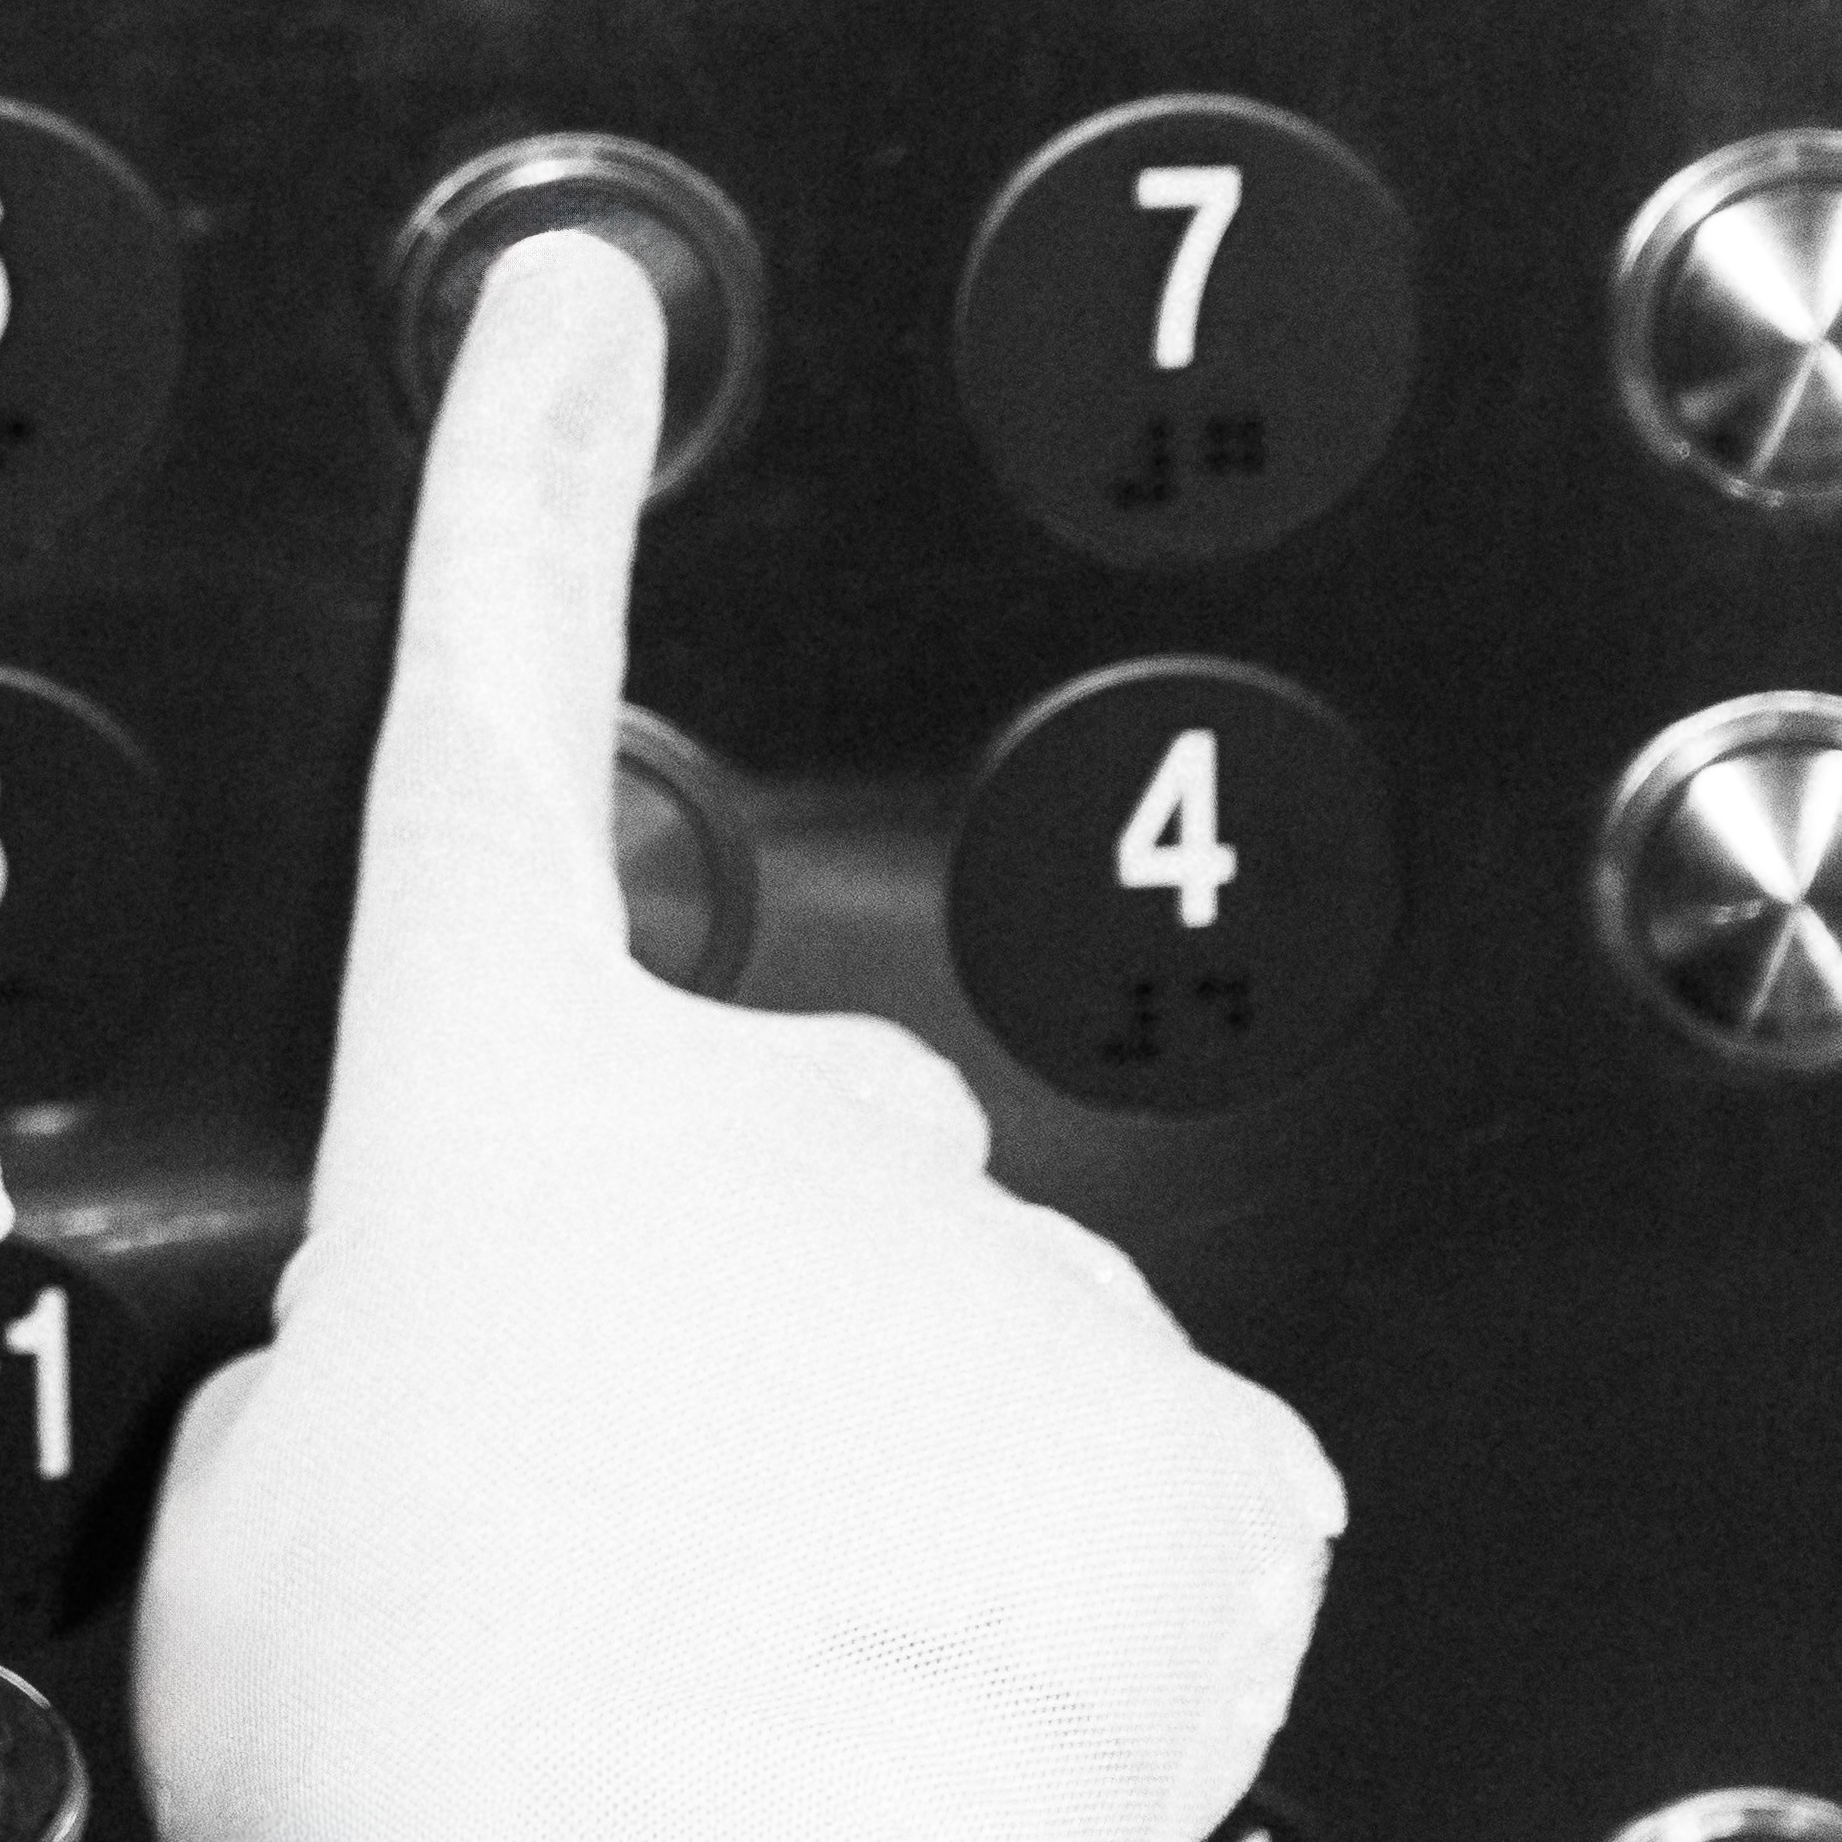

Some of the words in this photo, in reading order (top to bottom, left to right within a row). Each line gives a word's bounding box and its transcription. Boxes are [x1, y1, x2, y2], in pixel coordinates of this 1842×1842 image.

[1134, 165, 1243, 370] 7
[1116, 728, 1238, 928] 4
[4, 1287, 72, 1480] 1
